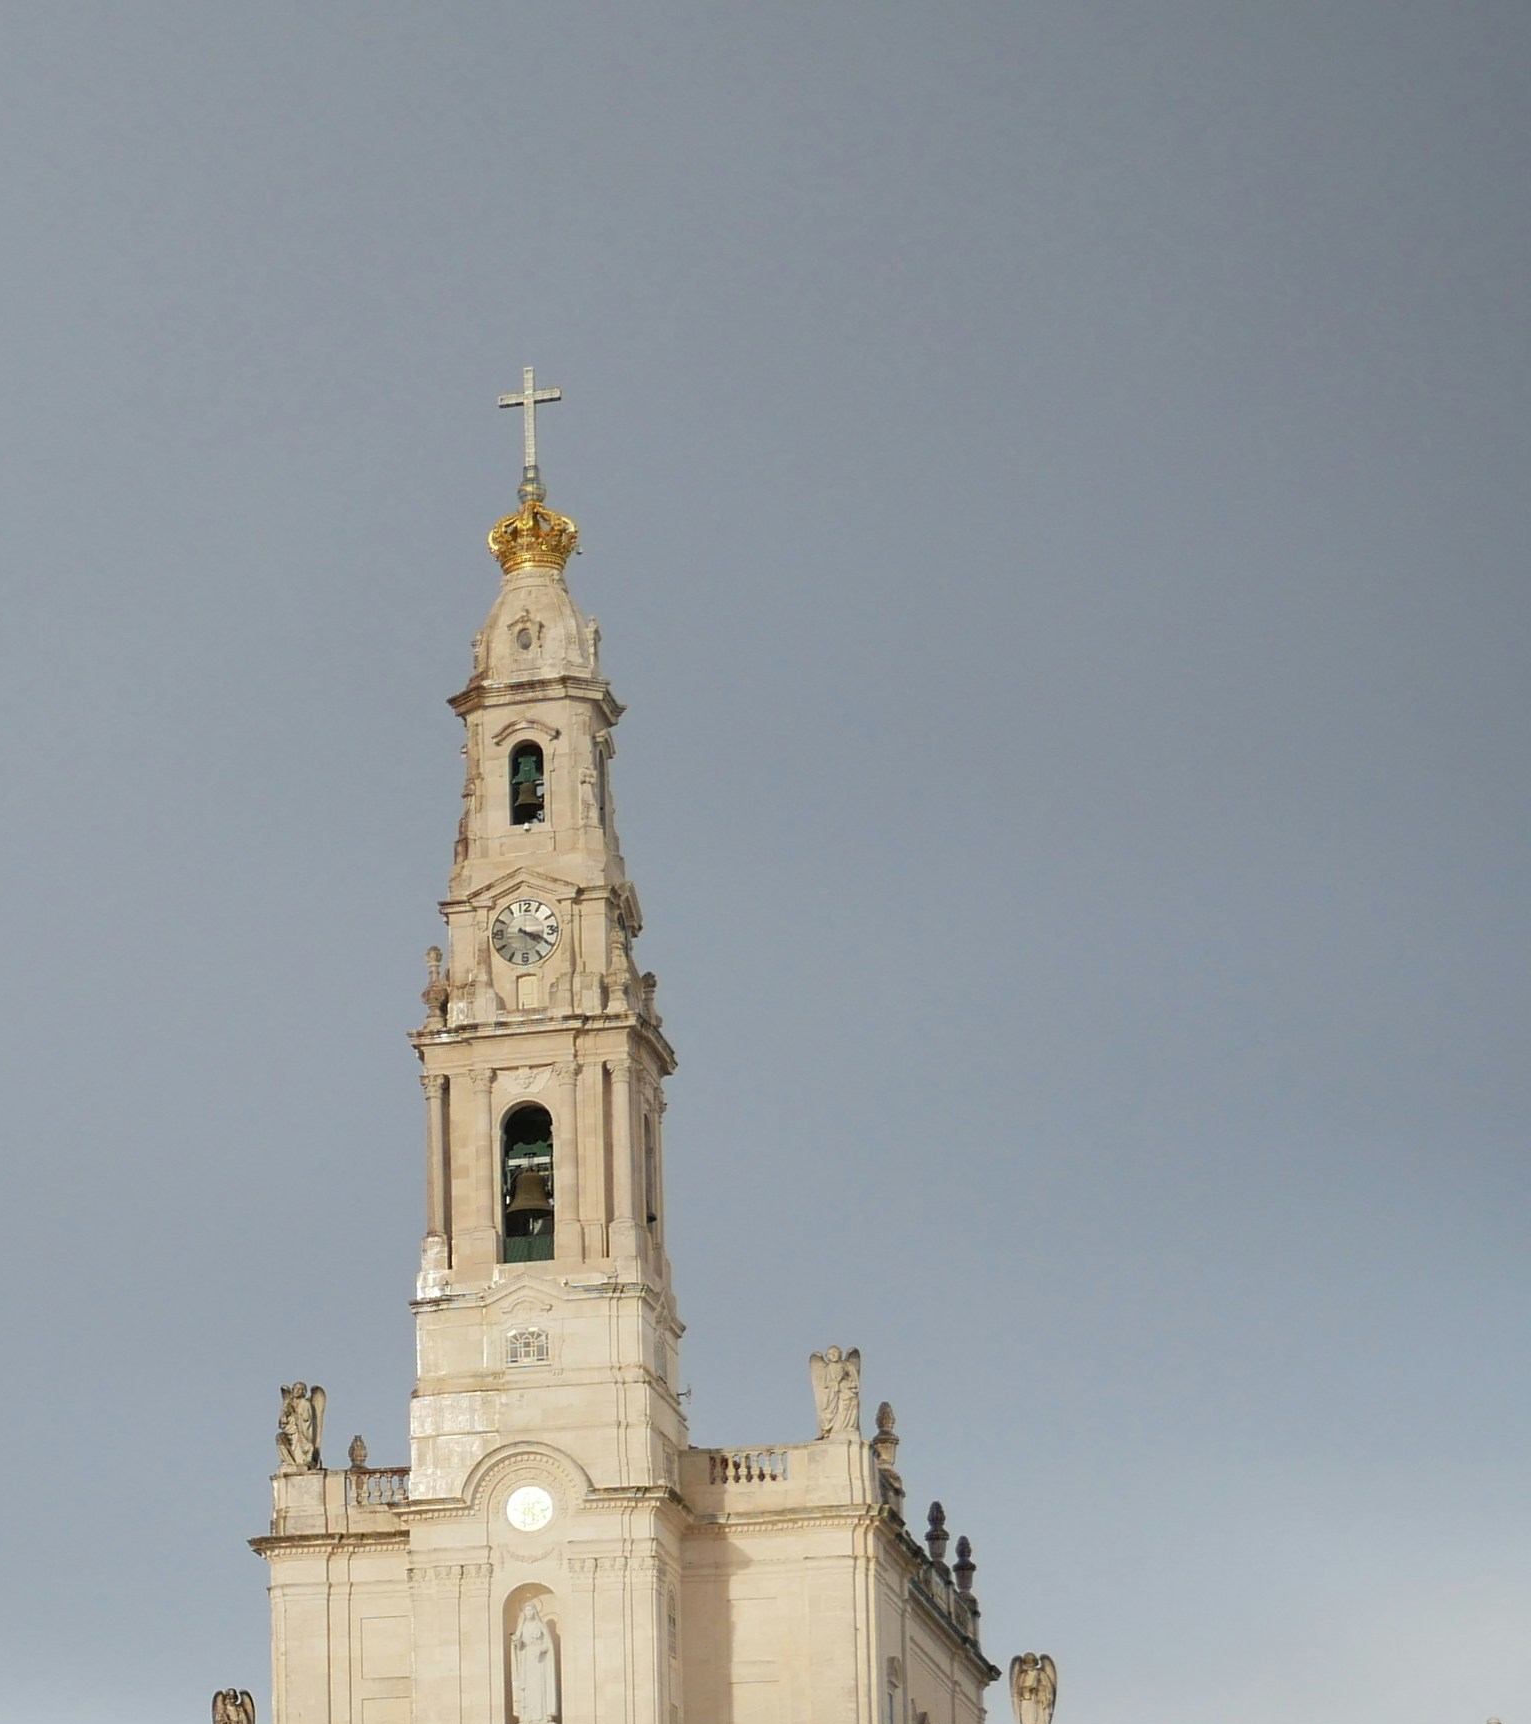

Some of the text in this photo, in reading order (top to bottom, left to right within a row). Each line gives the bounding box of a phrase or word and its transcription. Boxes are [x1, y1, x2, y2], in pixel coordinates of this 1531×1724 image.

[519, 902, 531, 913] 12
[546, 924, 555, 936] 3
[521, 952, 529, 963] 6
